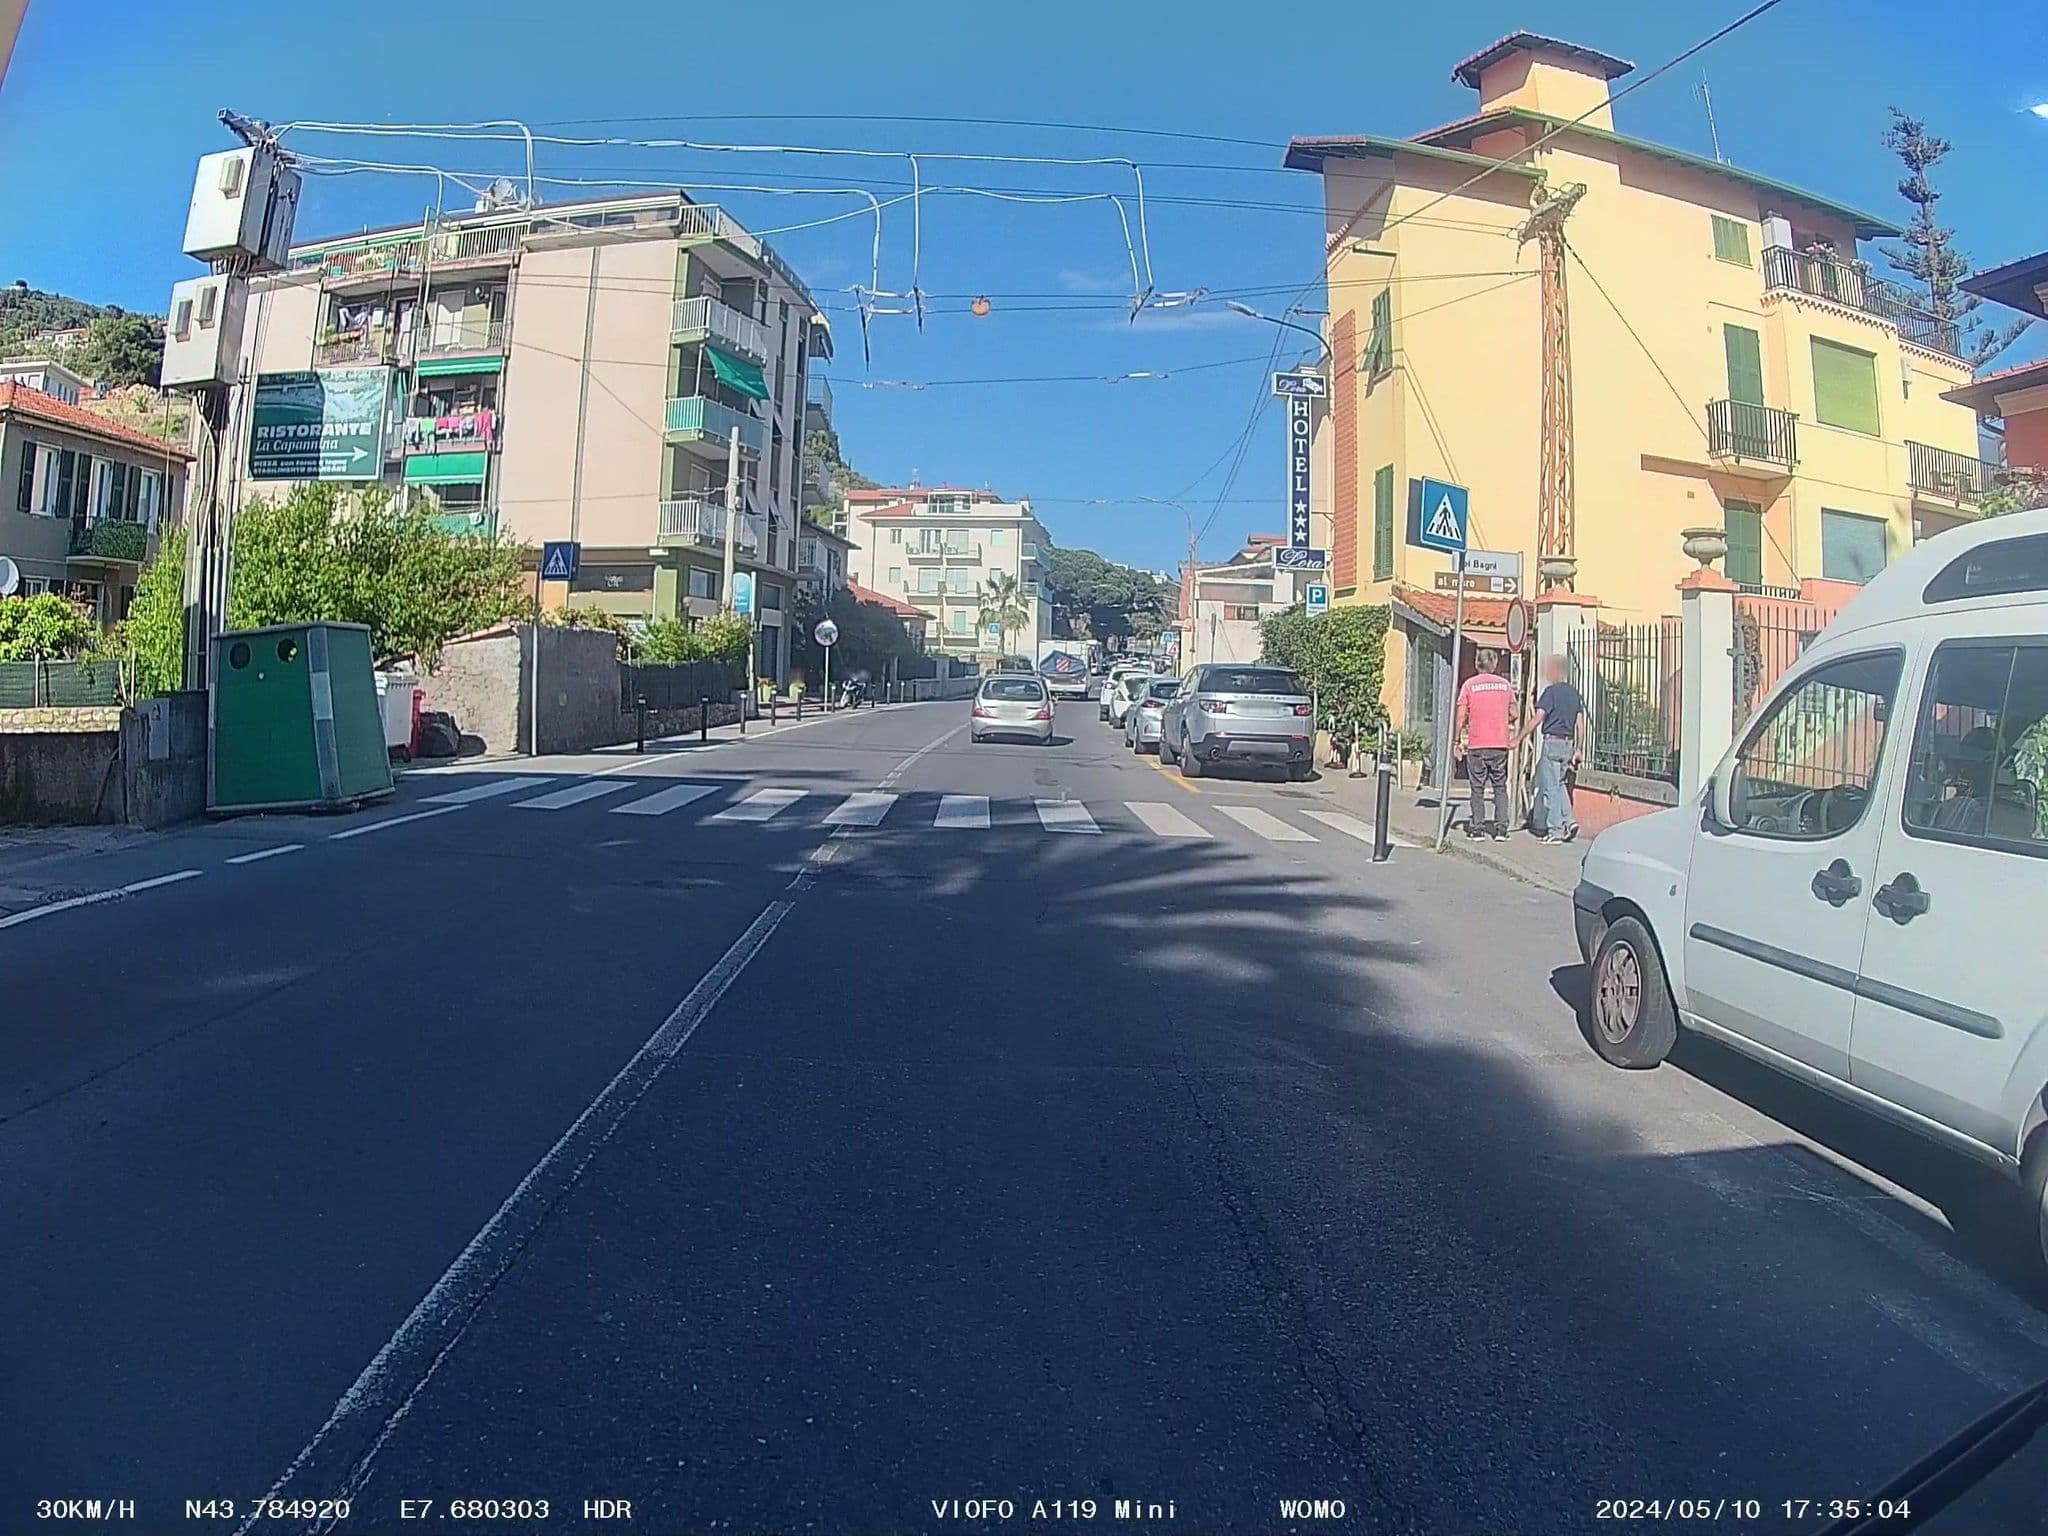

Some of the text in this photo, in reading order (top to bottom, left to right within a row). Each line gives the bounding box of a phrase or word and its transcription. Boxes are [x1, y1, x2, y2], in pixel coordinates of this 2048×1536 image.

[257, 422, 373, 439] RISTORANTE
[256, 439, 339, 454] La Capannina
[1293, 401, 1309, 492] HOTEL
[1473, 559, 1497, 571] Bagni
[1437, 575, 1448, 586] al
[1312, 588, 1322, 602] P
